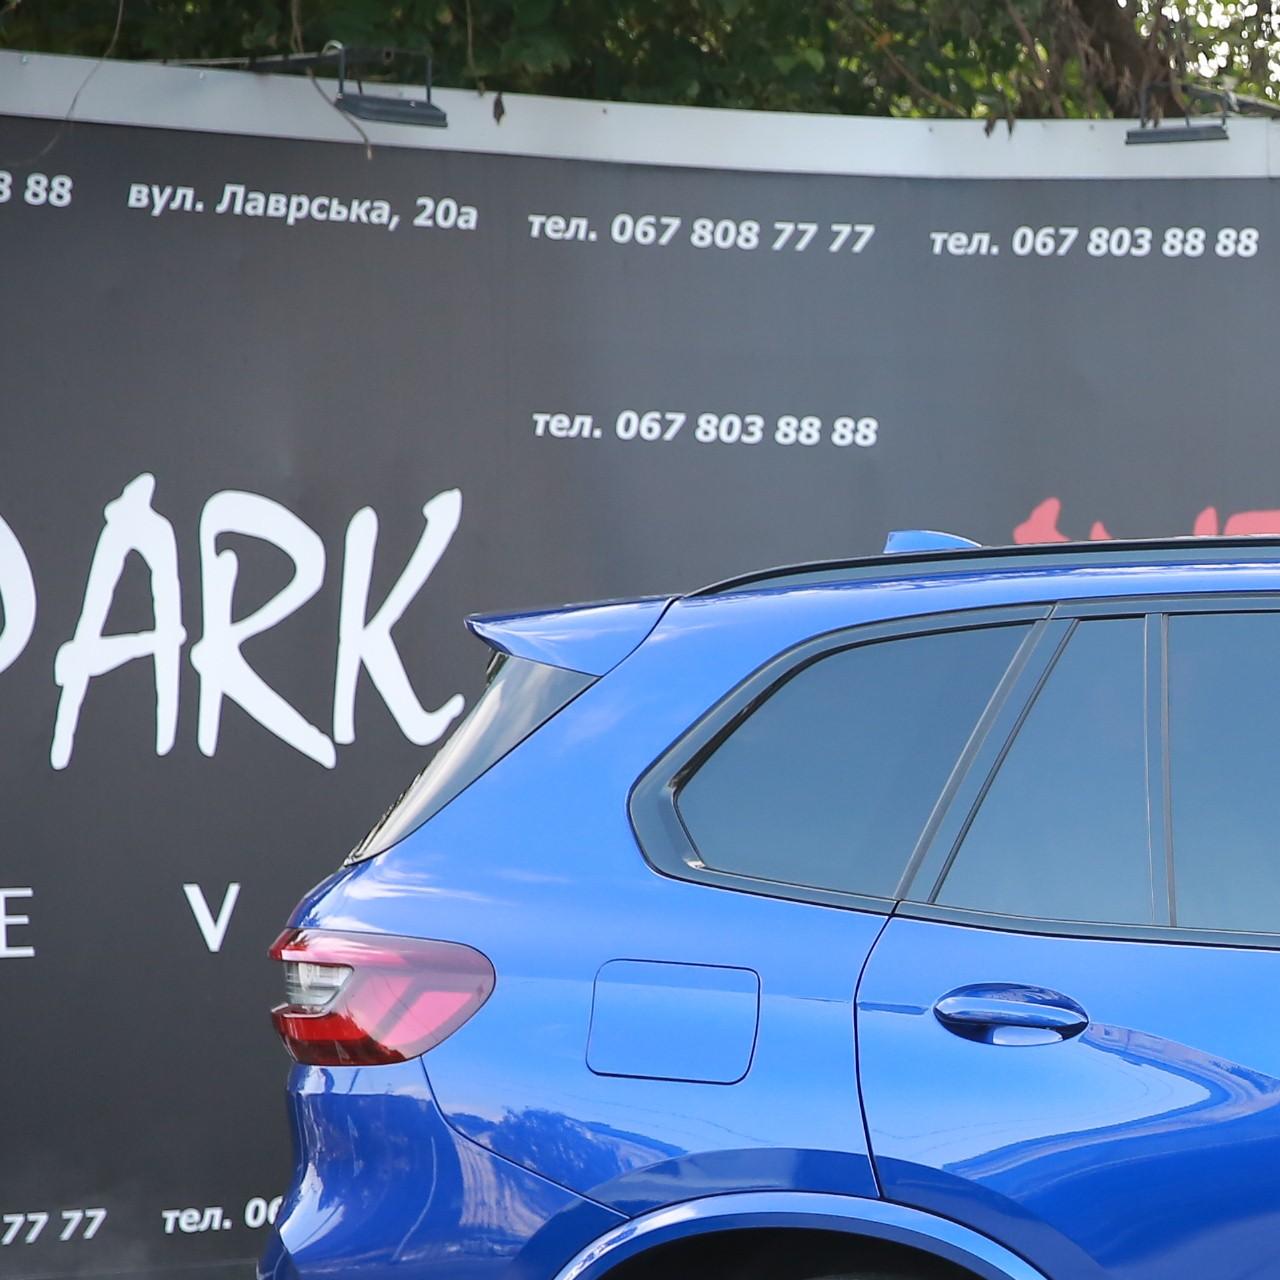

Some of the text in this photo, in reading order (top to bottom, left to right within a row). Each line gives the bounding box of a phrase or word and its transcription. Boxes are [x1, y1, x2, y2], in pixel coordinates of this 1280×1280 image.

[24, 172, 74, 208] 88
[128, 184, 478, 231] вул. Лаврська, 20а
[528, 214, 875, 253] тел. 067 808 77 77
[930, 226, 1259, 257] тел. 067 803 88 88
[532, 410, 878, 447] тел. 067 803 88 88
[1, 1208, 107, 1246] 77 77
[162, 1205, 233, 1235] тел.
